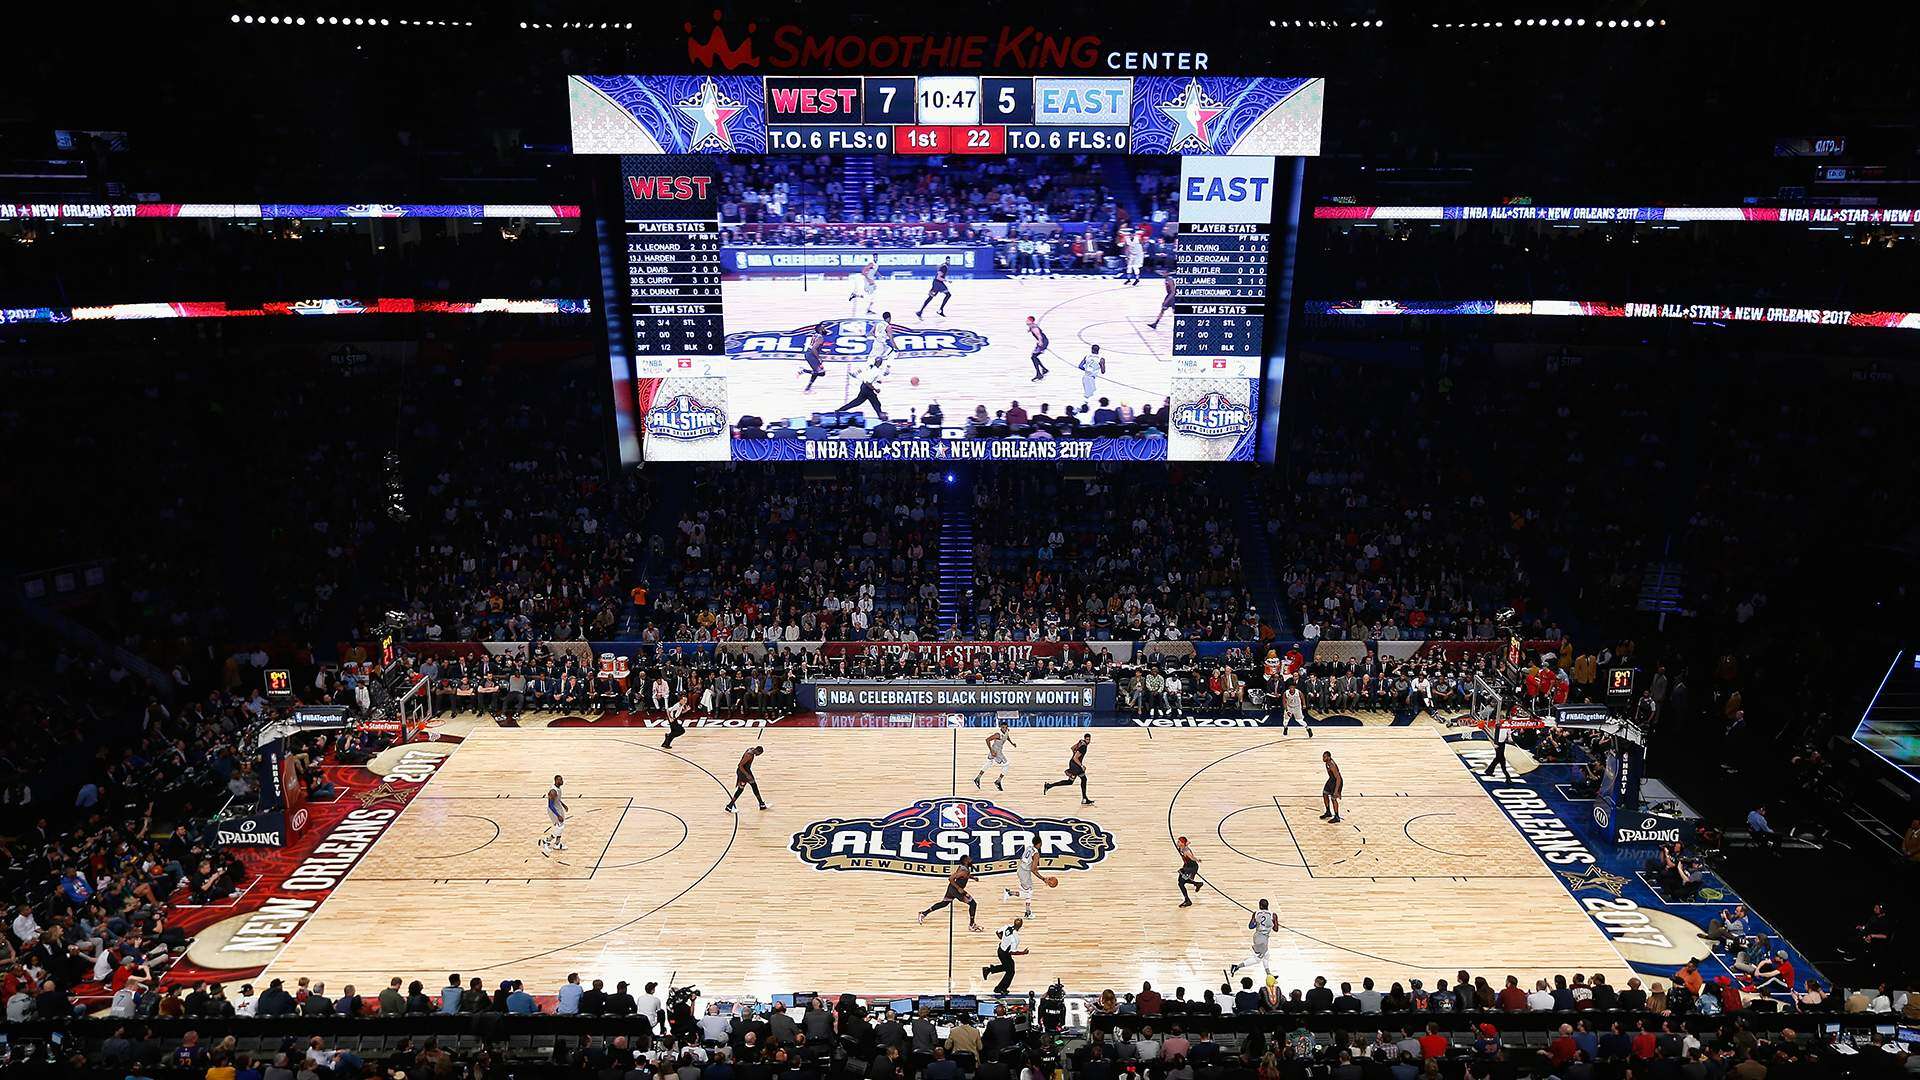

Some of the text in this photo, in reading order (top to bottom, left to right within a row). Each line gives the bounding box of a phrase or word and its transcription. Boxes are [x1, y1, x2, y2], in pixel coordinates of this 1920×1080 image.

[768, 25, 988, 69] SMOOTHIE
[1107, 52, 1209, 70] CENTER
[771, 88, 857, 114] WEST
[879, 88, 897, 113] 7
[919, 90, 977, 109] 10:47
[998, 88, 1016, 114] 5
[1043, 89, 1123, 114] EAST
[769, 131, 808, 149] T.O.
[811, 131, 822, 149] 6
[907, 131, 937, 147] 1st
[967, 130, 990, 148] 22
[1009, 131, 1047, 149] T.O.
[1049, 131, 1061, 149] 6
[628, 175, 711, 200] WEST
[1186, 177, 1269, 202] EAST
[31, 204, 59, 217] NEW
[62, 204, 112, 218] ORLEANS
[112, 204, 137, 217] 2017
[1470, 207, 1488, 219] NBA
[1547, 207, 1571, 220] NEW
[1573, 207, 1616, 220] ORLEANS
[1616, 207, 1640, 220] 2017
[1787, 208, 1810, 221] NBA
[1882, 208, 1912, 222] NEW
[638, 223, 705, 232] PLAYER STATS
[1191, 224, 1257, 233] PLAYER STATS
[628, 243, 634, 251] 2
[644, 243, 681, 251] LEONARD
[1178, 244, 1184, 252] 2
[1194, 244, 1220, 252] IRVING
[629, 254, 636, 262] 13
[644, 254, 676, 262] HARDEN
[1178, 255, 1184, 263] 10
[1194, 255, 1230, 263] DEROZAN
[629, 266, 637, 274] 23
[646, 266, 669, 274] DAVIS
[1176, 266, 1183, 274] 21
[1192, 266, 1221, 274] BUTLER
[647, 276, 673, 284] CURRY
[1192, 277, 1217, 285] JAMES
[649, 288, 680, 296] DURANT
[649, 305, 706, 314] TEAM STATS
[1191, 305, 1247, 314] TEAM STATS
[1634, 303, 1658, 318] NBA
[1734, 306, 1762, 321] NEW
[1766, 307, 1820, 324] ORLEANS
[1821, 310, 1852, 325] 2017
[1222, 319, 1236, 327] STL
[1245, 319, 1251, 327] 0
[636, 331, 646, 339] FT
[1176, 331, 1185, 339] FT
[1224, 331, 1233, 339] TO
[660, 343, 672, 351] 1/2
[683, 343, 698, 351] BLK
[707, 343, 713, 351] 0
[1220, 344, 1235, 352] BLK
[1244, 344, 1250, 352] 0
[817, 440, 849, 459] NBA
[951, 440, 987, 459] NEW
[991, 440, 1056, 459] ORLEANS
[1059, 440, 1094, 459] 2017
[272, 679, 285, 688] 21
[1614, 677, 1627, 687] 21
[830, 690, 1079, 704] NBA CELEBRATES BLACK HISTORY MONTH
[302, 714, 342, 722] #NBATogether
[1131, 716, 1259, 727] verizon
[1565, 712, 1605, 721] #NBATogether
[382, 750, 450, 783] 2017
[293, 811, 307, 829] KIA
[1595, 808, 1607, 827] KIA
[1491, 788, 1597, 866] ORLEANS
[217, 830, 280, 846] SPALDING
[1618, 828, 1680, 843] SPALDING
[282, 809, 397, 891] ORLEANS
[850, 857, 1054, 874] NEW ORLENS 27
[221, 898, 318, 952] NEW
[1260, 915, 1267, 926] 2
[1582, 897, 1673, 949] 2017
